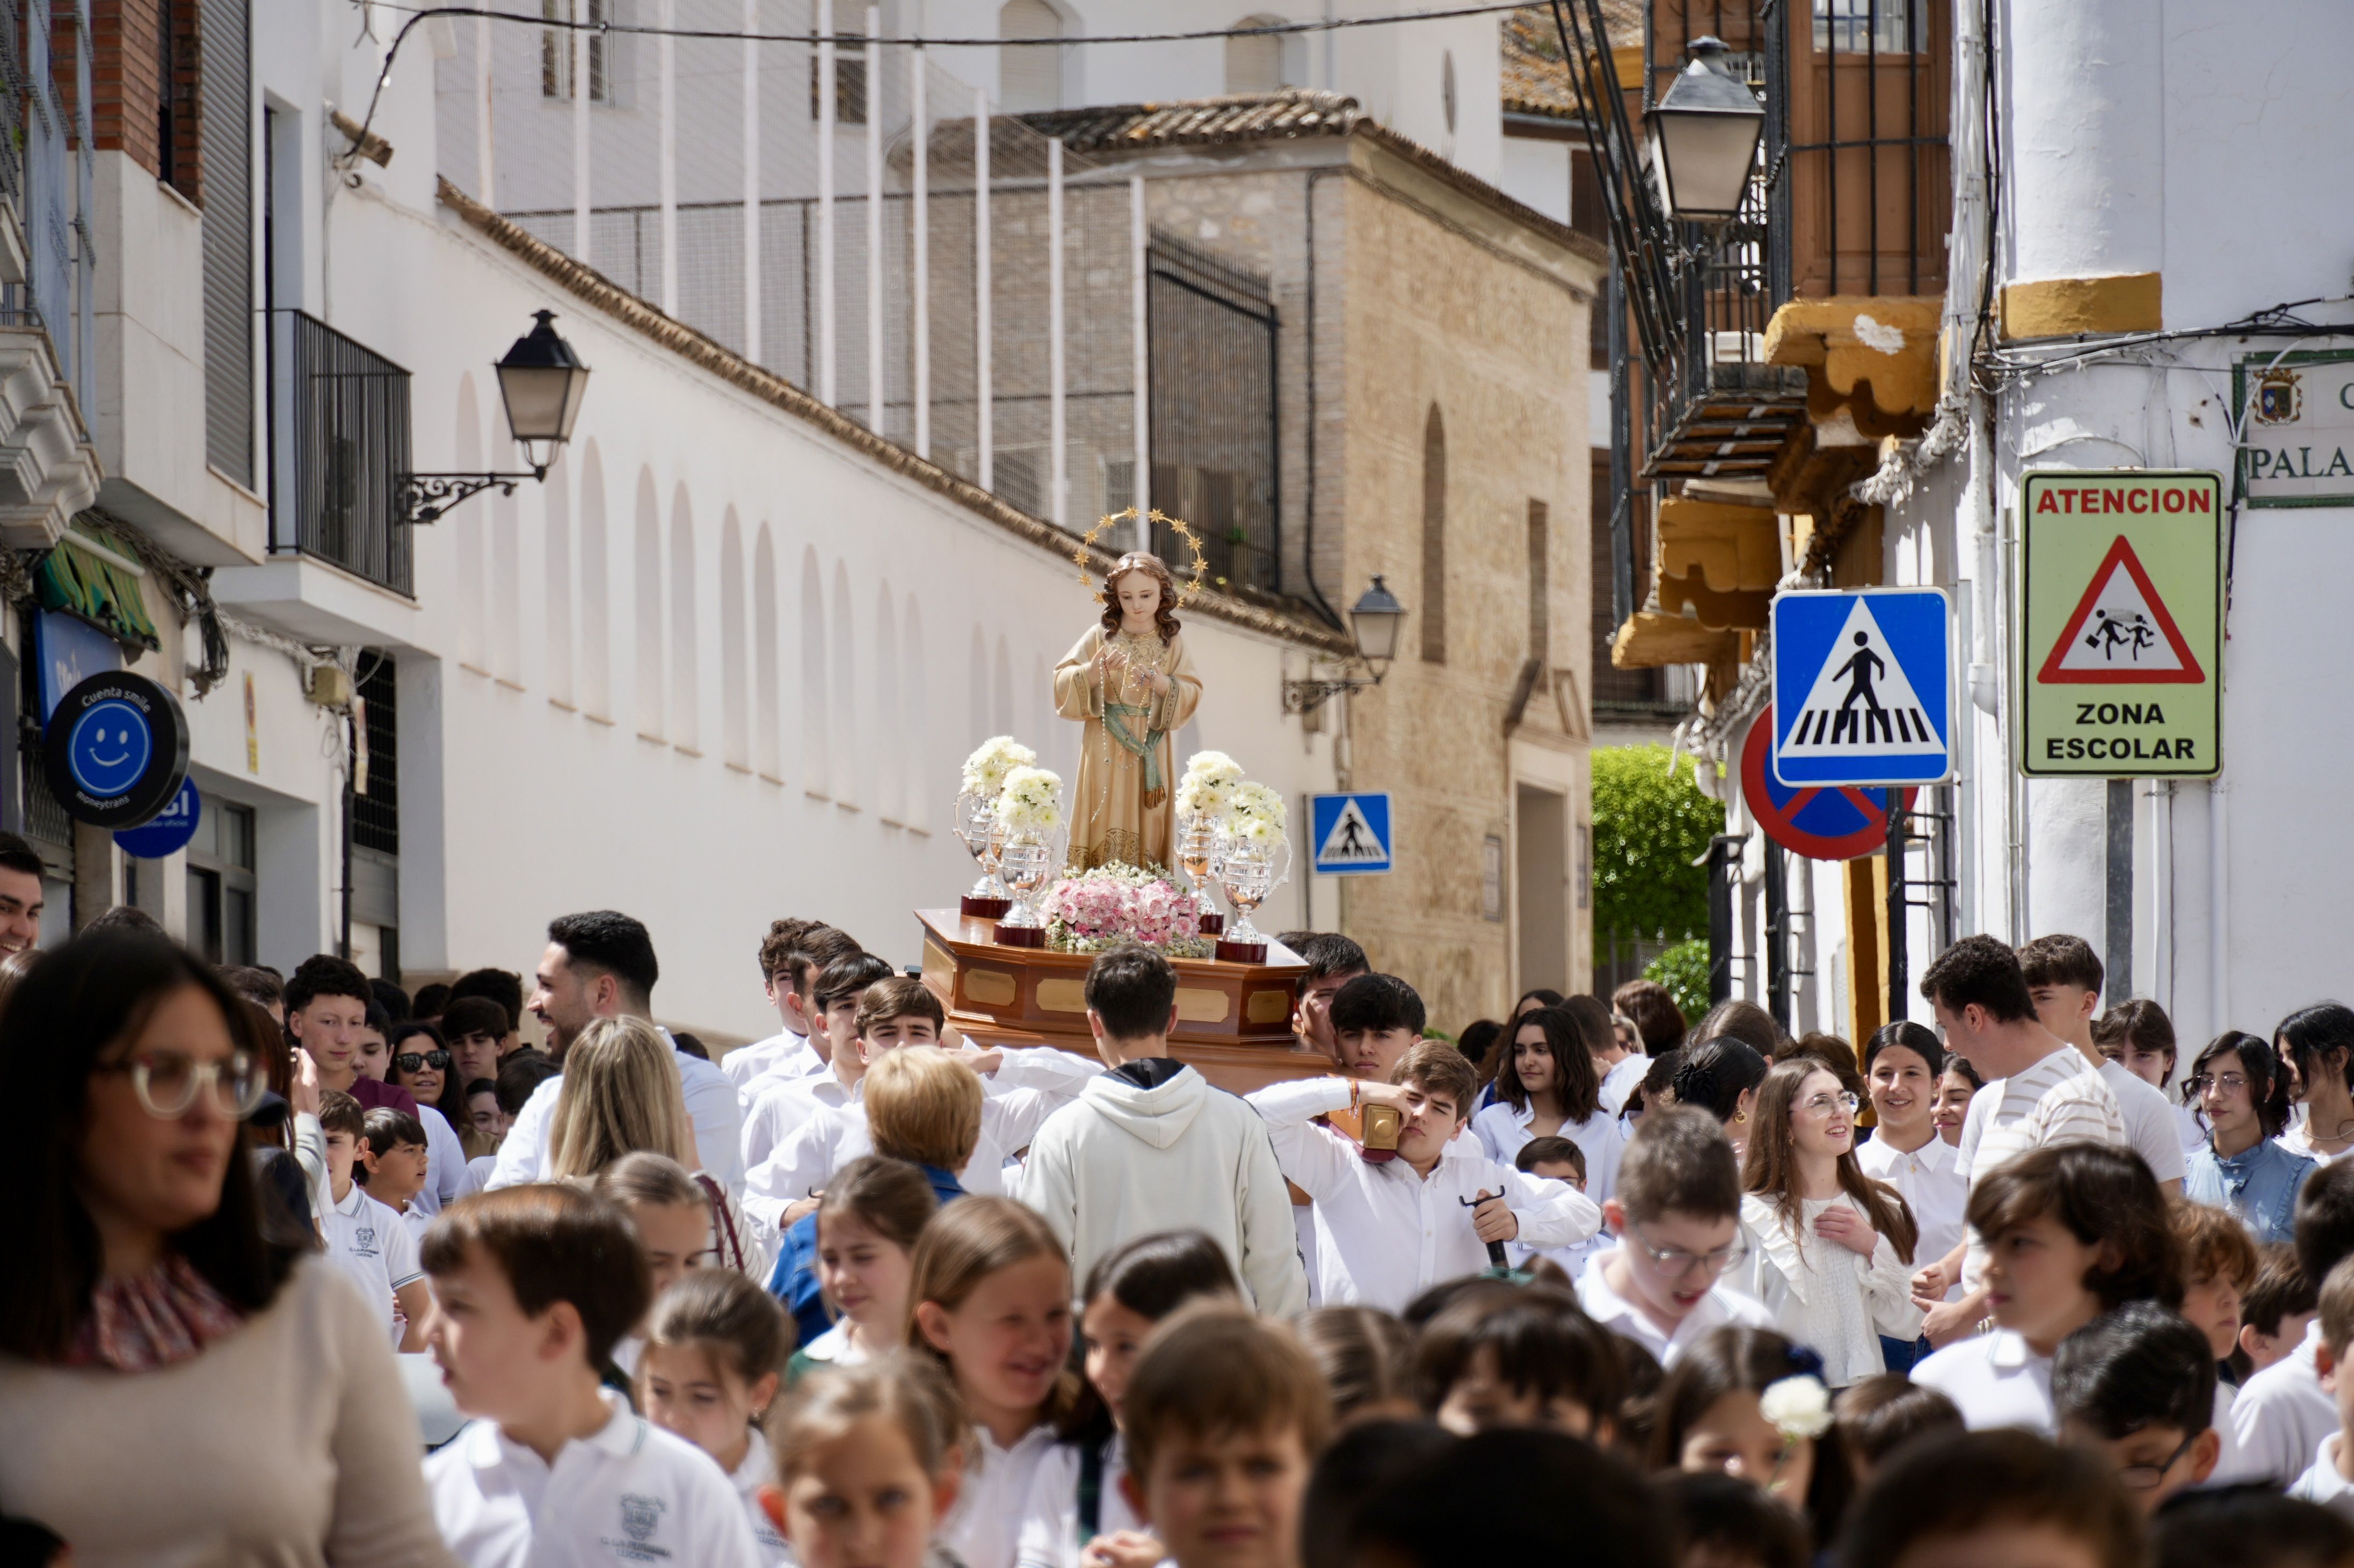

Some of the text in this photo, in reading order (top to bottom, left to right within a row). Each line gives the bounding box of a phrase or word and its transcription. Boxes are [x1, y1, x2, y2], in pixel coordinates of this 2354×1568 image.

[2036, 488, 2210, 514] ATENCION
[81, 686, 151, 713] Cuenta smile
[2075, 703, 2165, 724] ZONA
[2046, 738, 2196, 760] ESCOLAR
[76, 790, 130, 811] moneytrans
